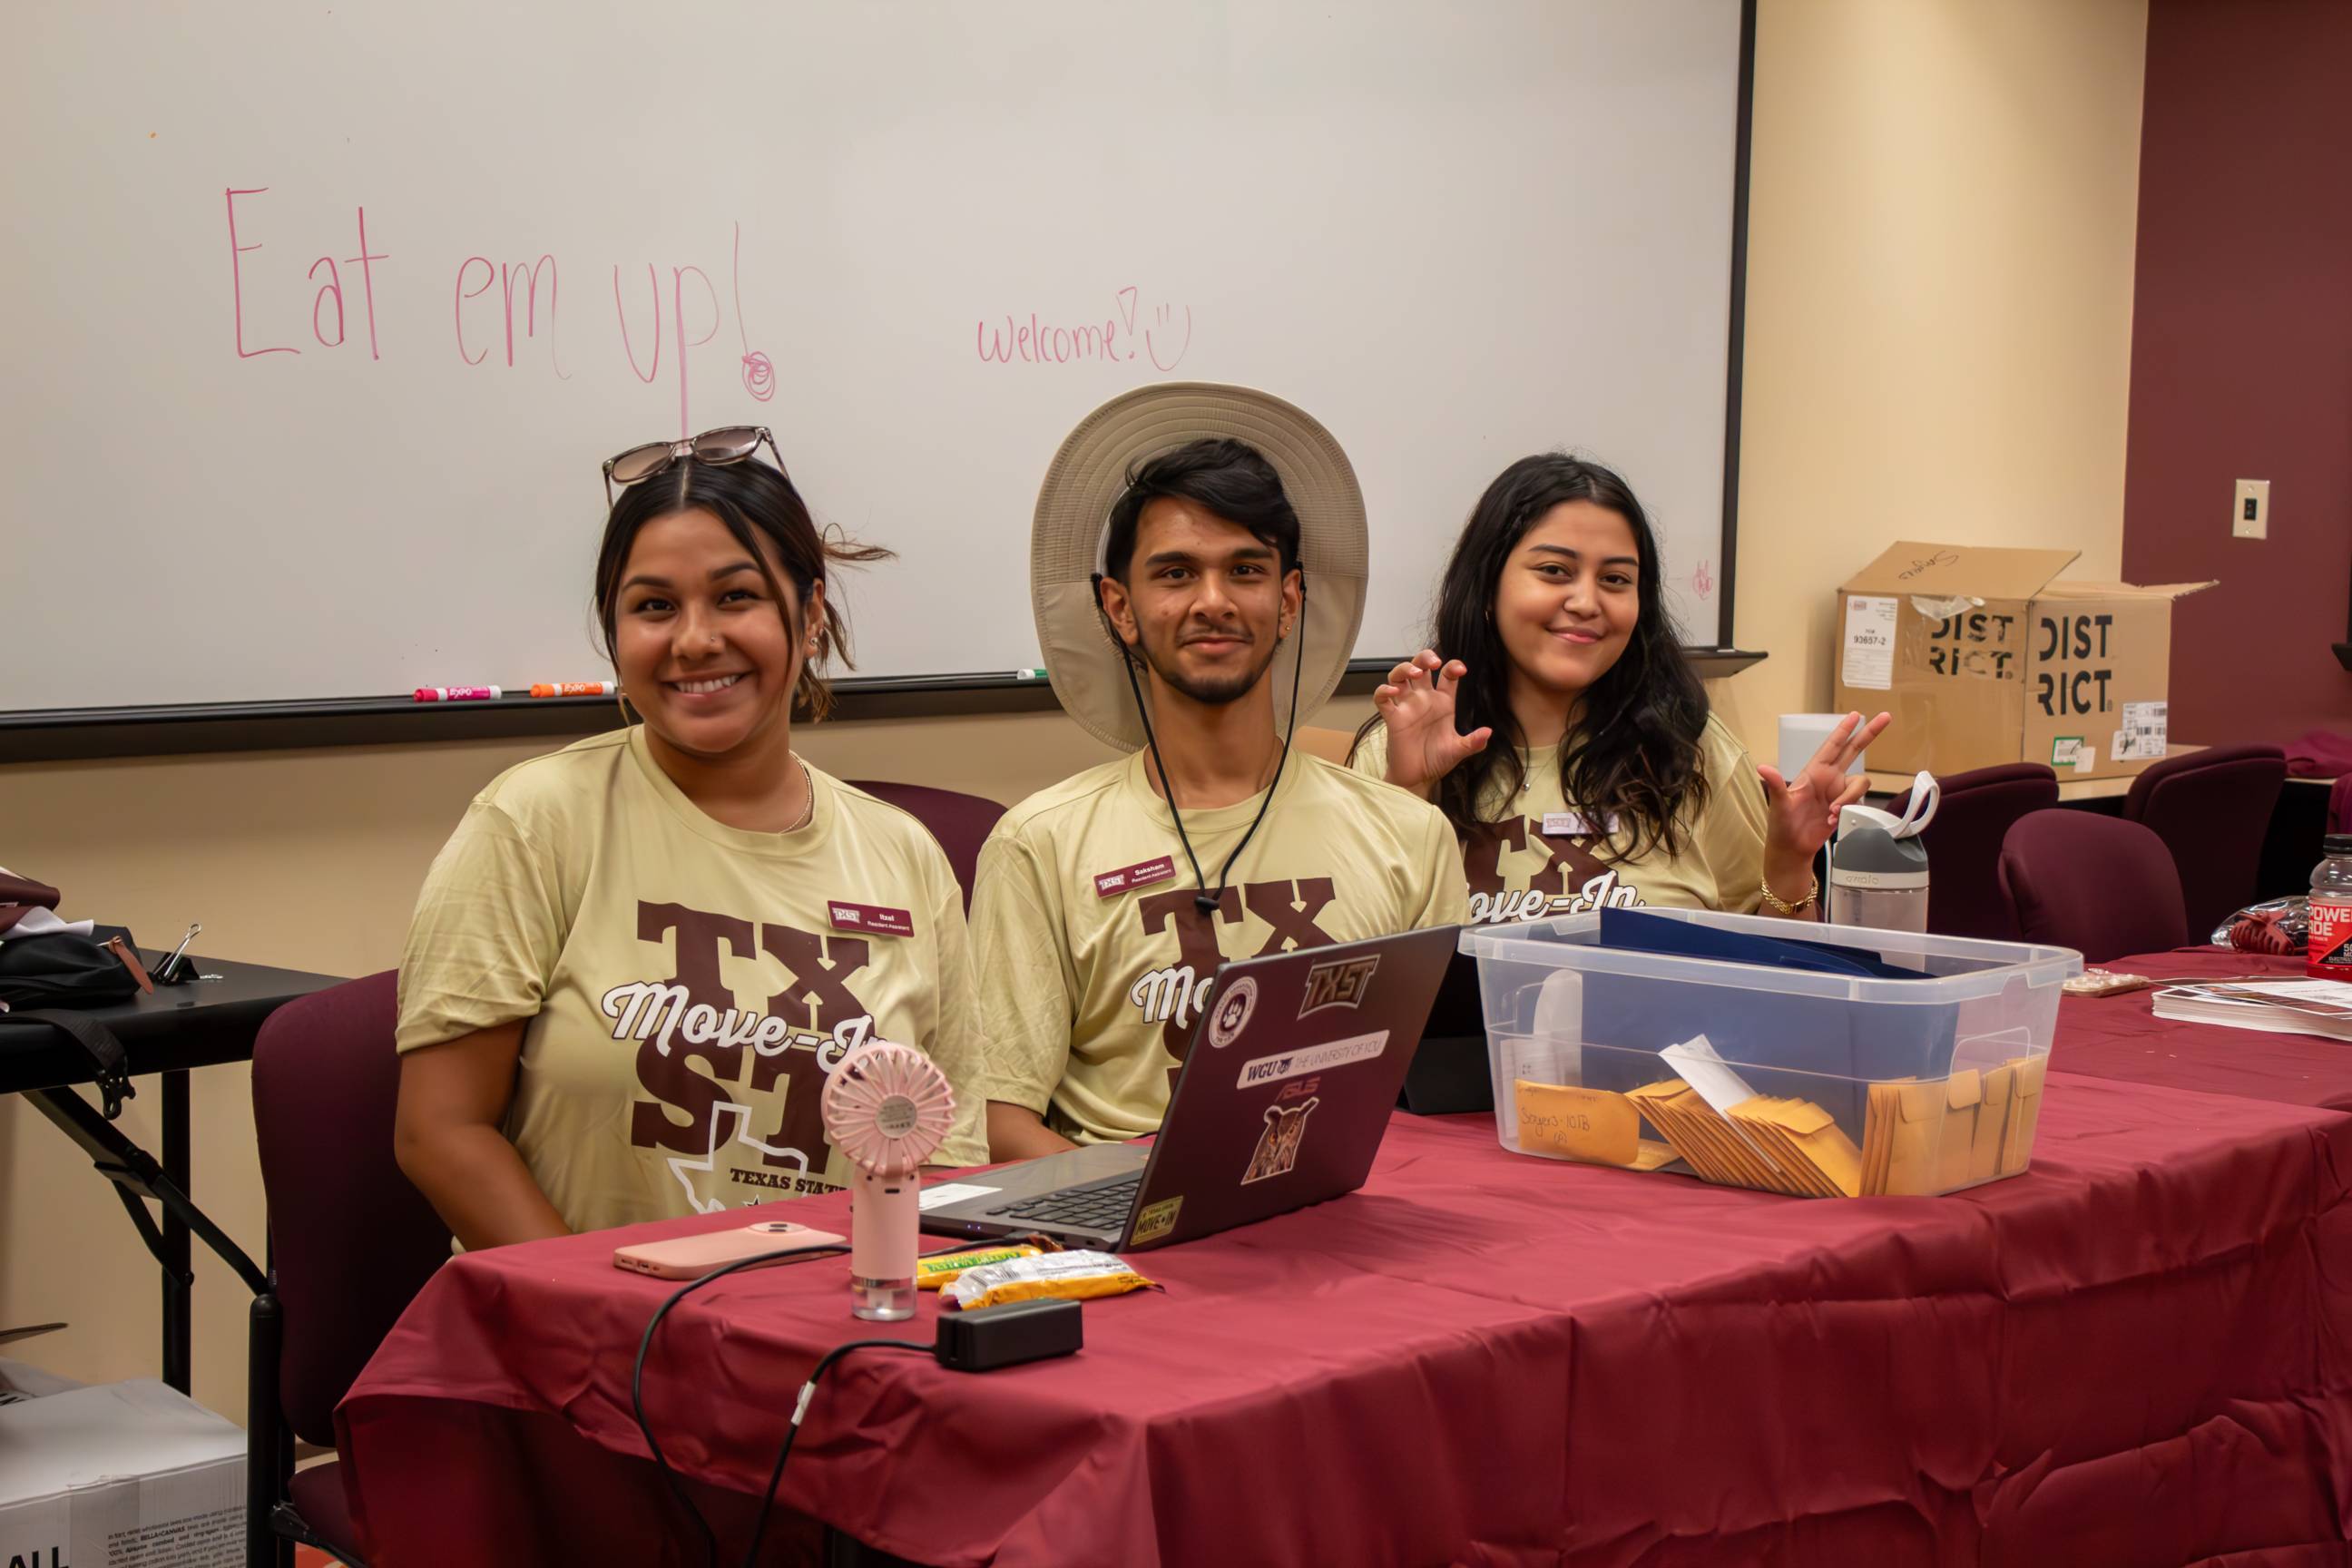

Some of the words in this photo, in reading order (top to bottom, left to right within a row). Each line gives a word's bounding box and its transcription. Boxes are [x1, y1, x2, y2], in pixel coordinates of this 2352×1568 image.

[226, 187, 389, 360] Eat
[456, 254, 572, 379] em
[1931, 613, 2014, 642] DIST
[2039, 614, 2112, 662] DIST
[2037, 670, 2112, 716] RICT
[1134, 863, 1164, 876] Saksham
[1465, 869, 1647, 923] ove-In
[2308, 905, 2352, 923] POWE
[637, 898, 875, 1036] TX
[1303, 958, 1377, 1011] TXST
[602, 980, 887, 1074] Move-I
[1247, 1060, 1279, 1082] WGU
[1275, 1076, 1321, 1102] ASUS
[730, 1168, 791, 1190] TEXAS
[795, 1179, 847, 1194] STAT
